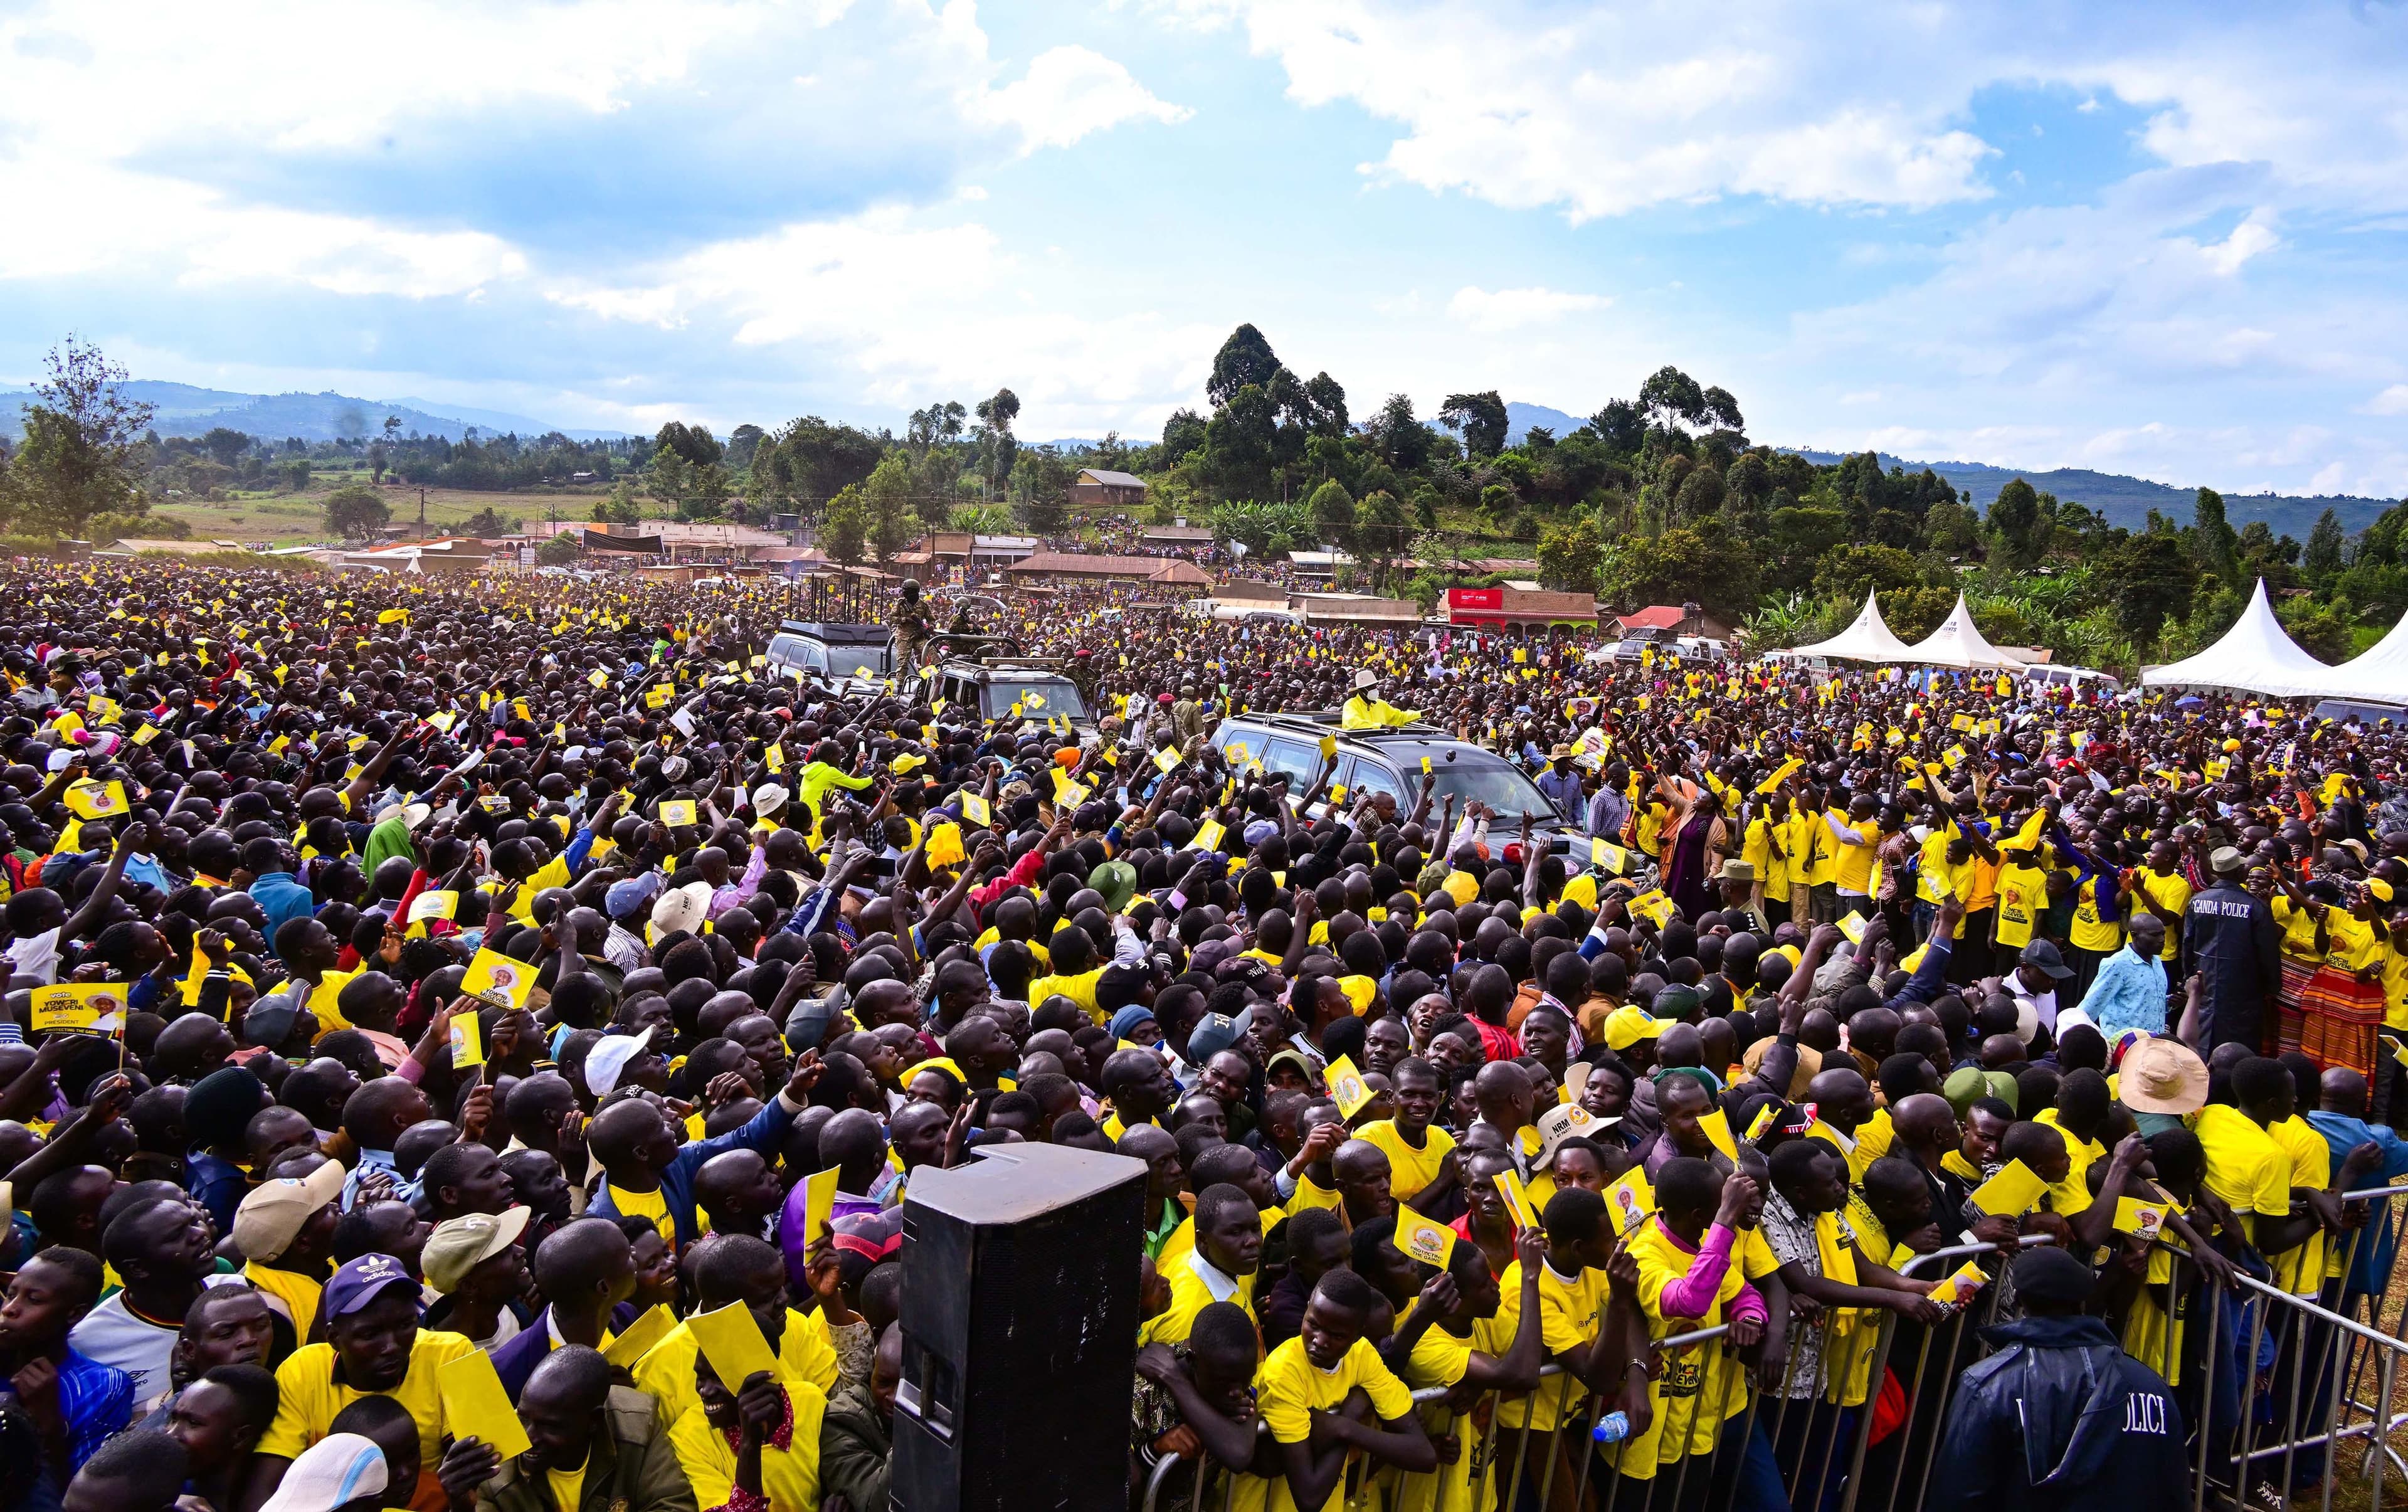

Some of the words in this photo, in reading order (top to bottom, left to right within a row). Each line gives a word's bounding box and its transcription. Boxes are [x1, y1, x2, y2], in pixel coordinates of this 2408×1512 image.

[2221, 902, 2249, 918] POLICE
[2328, 954, 2348, 965] OWERI
[39, 1005, 83, 1013] MUSEVENI
[1551, 1118, 1570, 1134] NRM
[1561, 1127, 1571, 1136] PARTY
[1410, 1245, 1444, 1261] PROTECTING
[1423, 1255, 1440, 1263] GAINS
[362, 1271, 396, 1283] adidas
